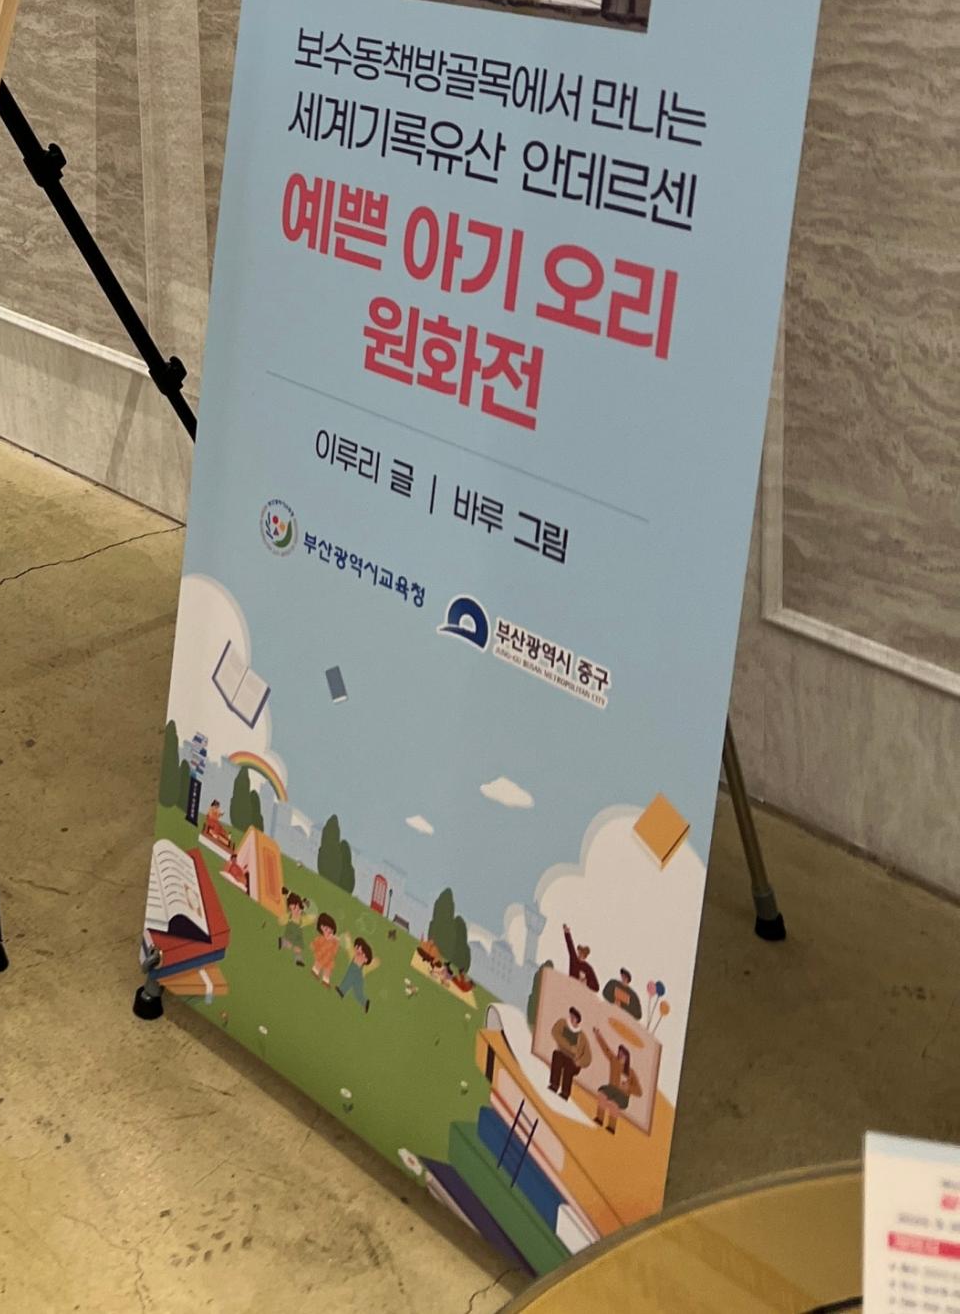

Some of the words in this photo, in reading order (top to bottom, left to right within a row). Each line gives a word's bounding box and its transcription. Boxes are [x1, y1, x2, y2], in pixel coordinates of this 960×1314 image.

[294, 27, 583, 122] 보수동책방골목에서
[590, 79, 708, 146] 만나는
[288, 91, 507, 184] 세계기록유산
[522, 140, 698, 231] 안데르센
[281, 173, 390, 272] 예쁜
[403, 205, 524, 313] 아기
[535, 244, 679, 361] 오리
[363, 296, 544, 432] 원화전
[315, 429, 381, 484] 이루리
[390, 458, 415, 498] 글
[453, 485, 504, 534] 바루
[513, 510, 569, 564] 그림
[303, 531, 427, 608] 부산광역시교육청
[495, 620, 572, 676] 부산광역시
[577, 658, 609, 691] 중구
